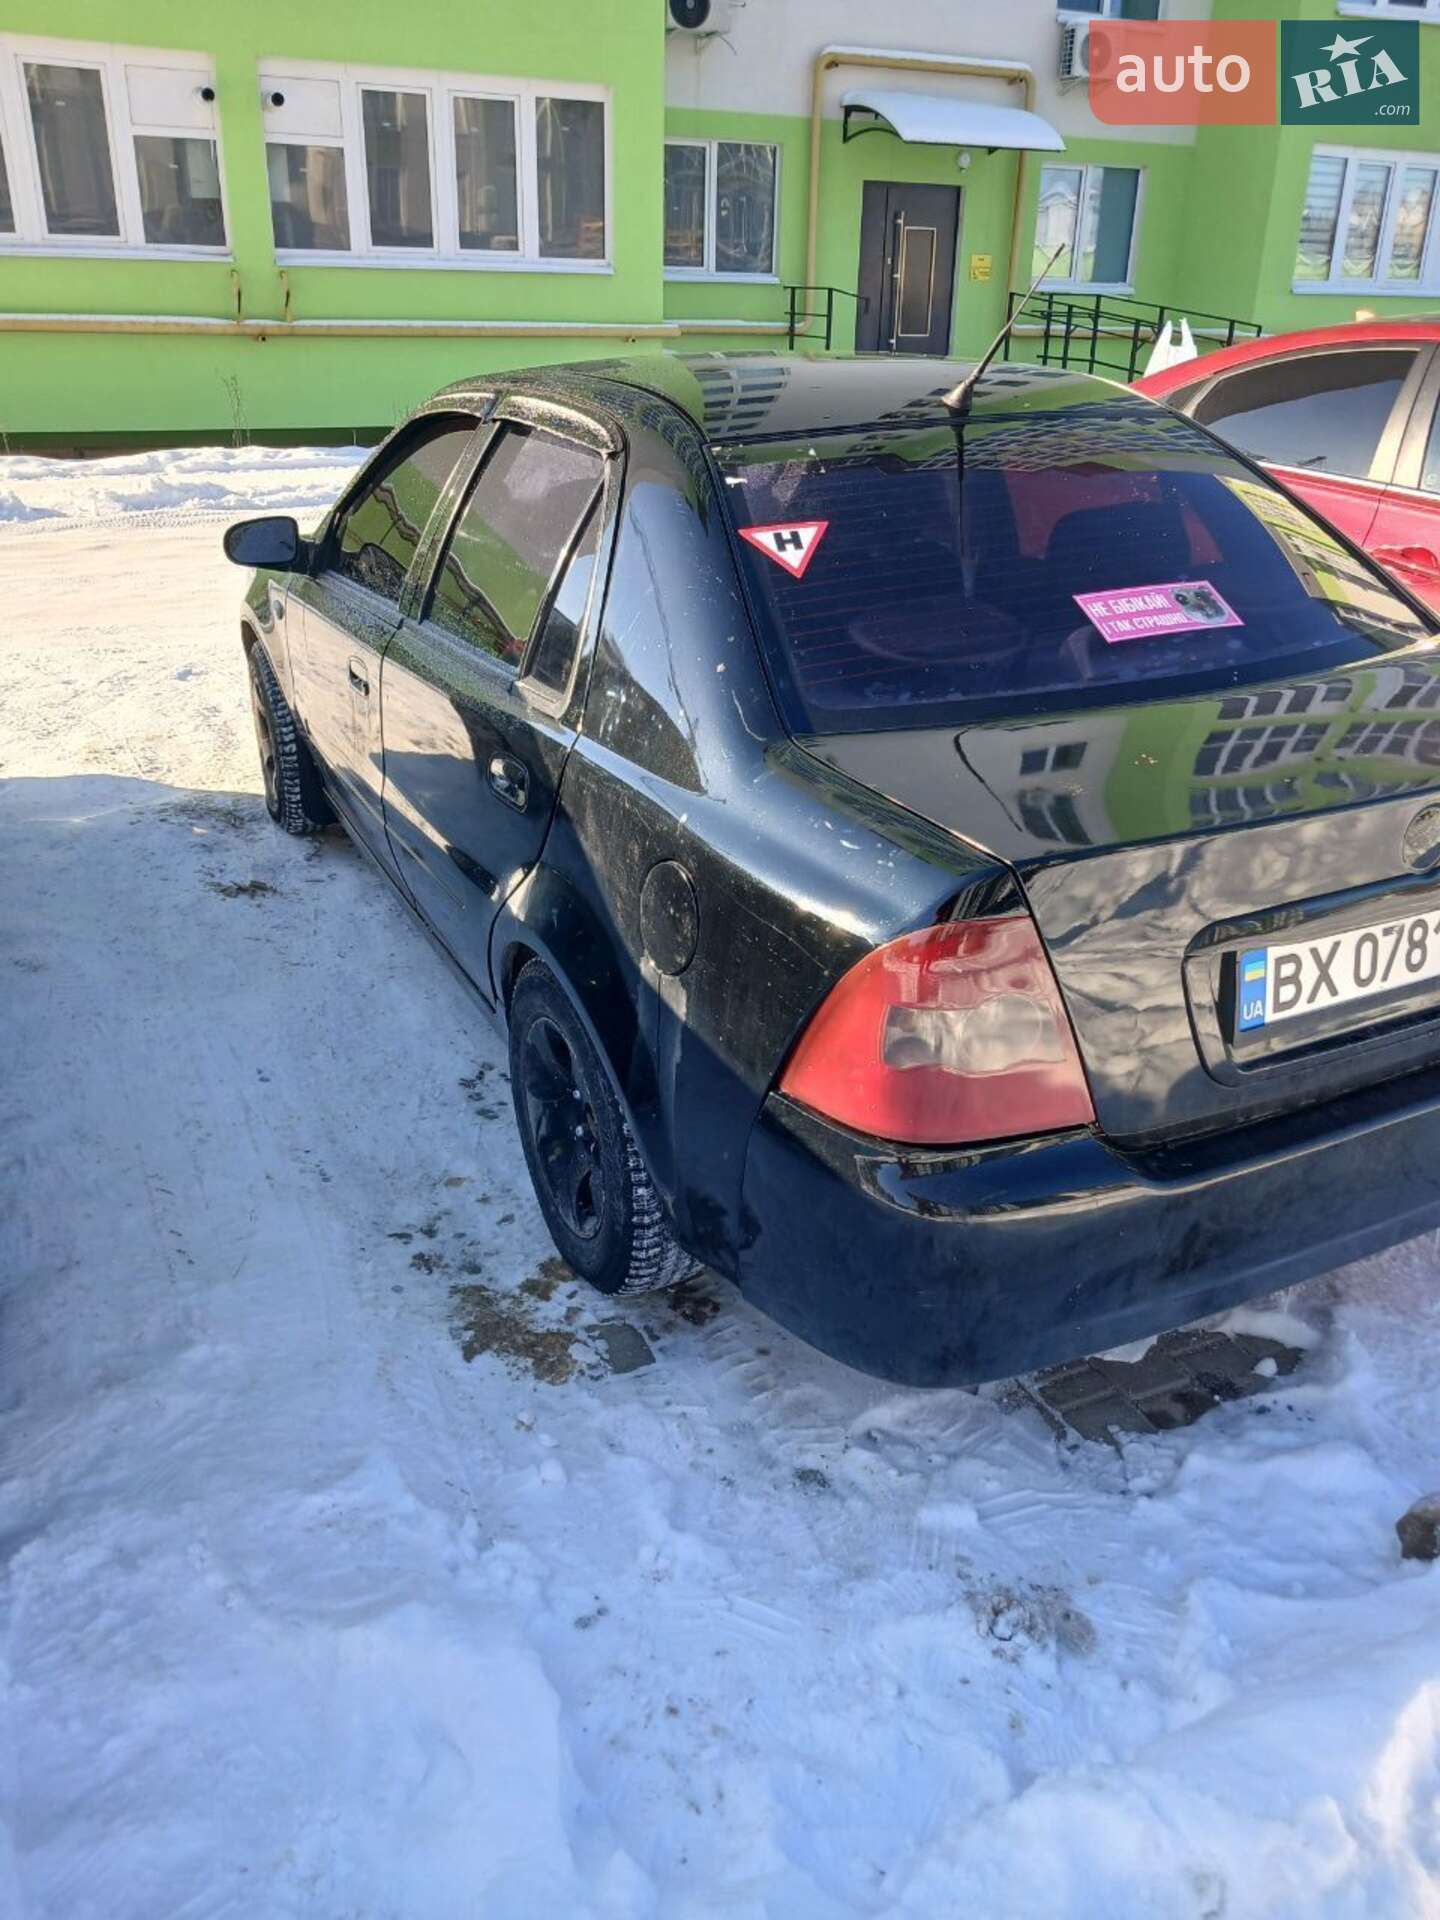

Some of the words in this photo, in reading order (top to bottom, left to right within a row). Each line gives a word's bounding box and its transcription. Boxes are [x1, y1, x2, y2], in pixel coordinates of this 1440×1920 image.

[1087, 601, 1112, 617] НЕ
[1272, 940, 1342, 1014] BX
[1353, 918, 1440, 988] 078
[1243, 1000, 1263, 1020] UA
